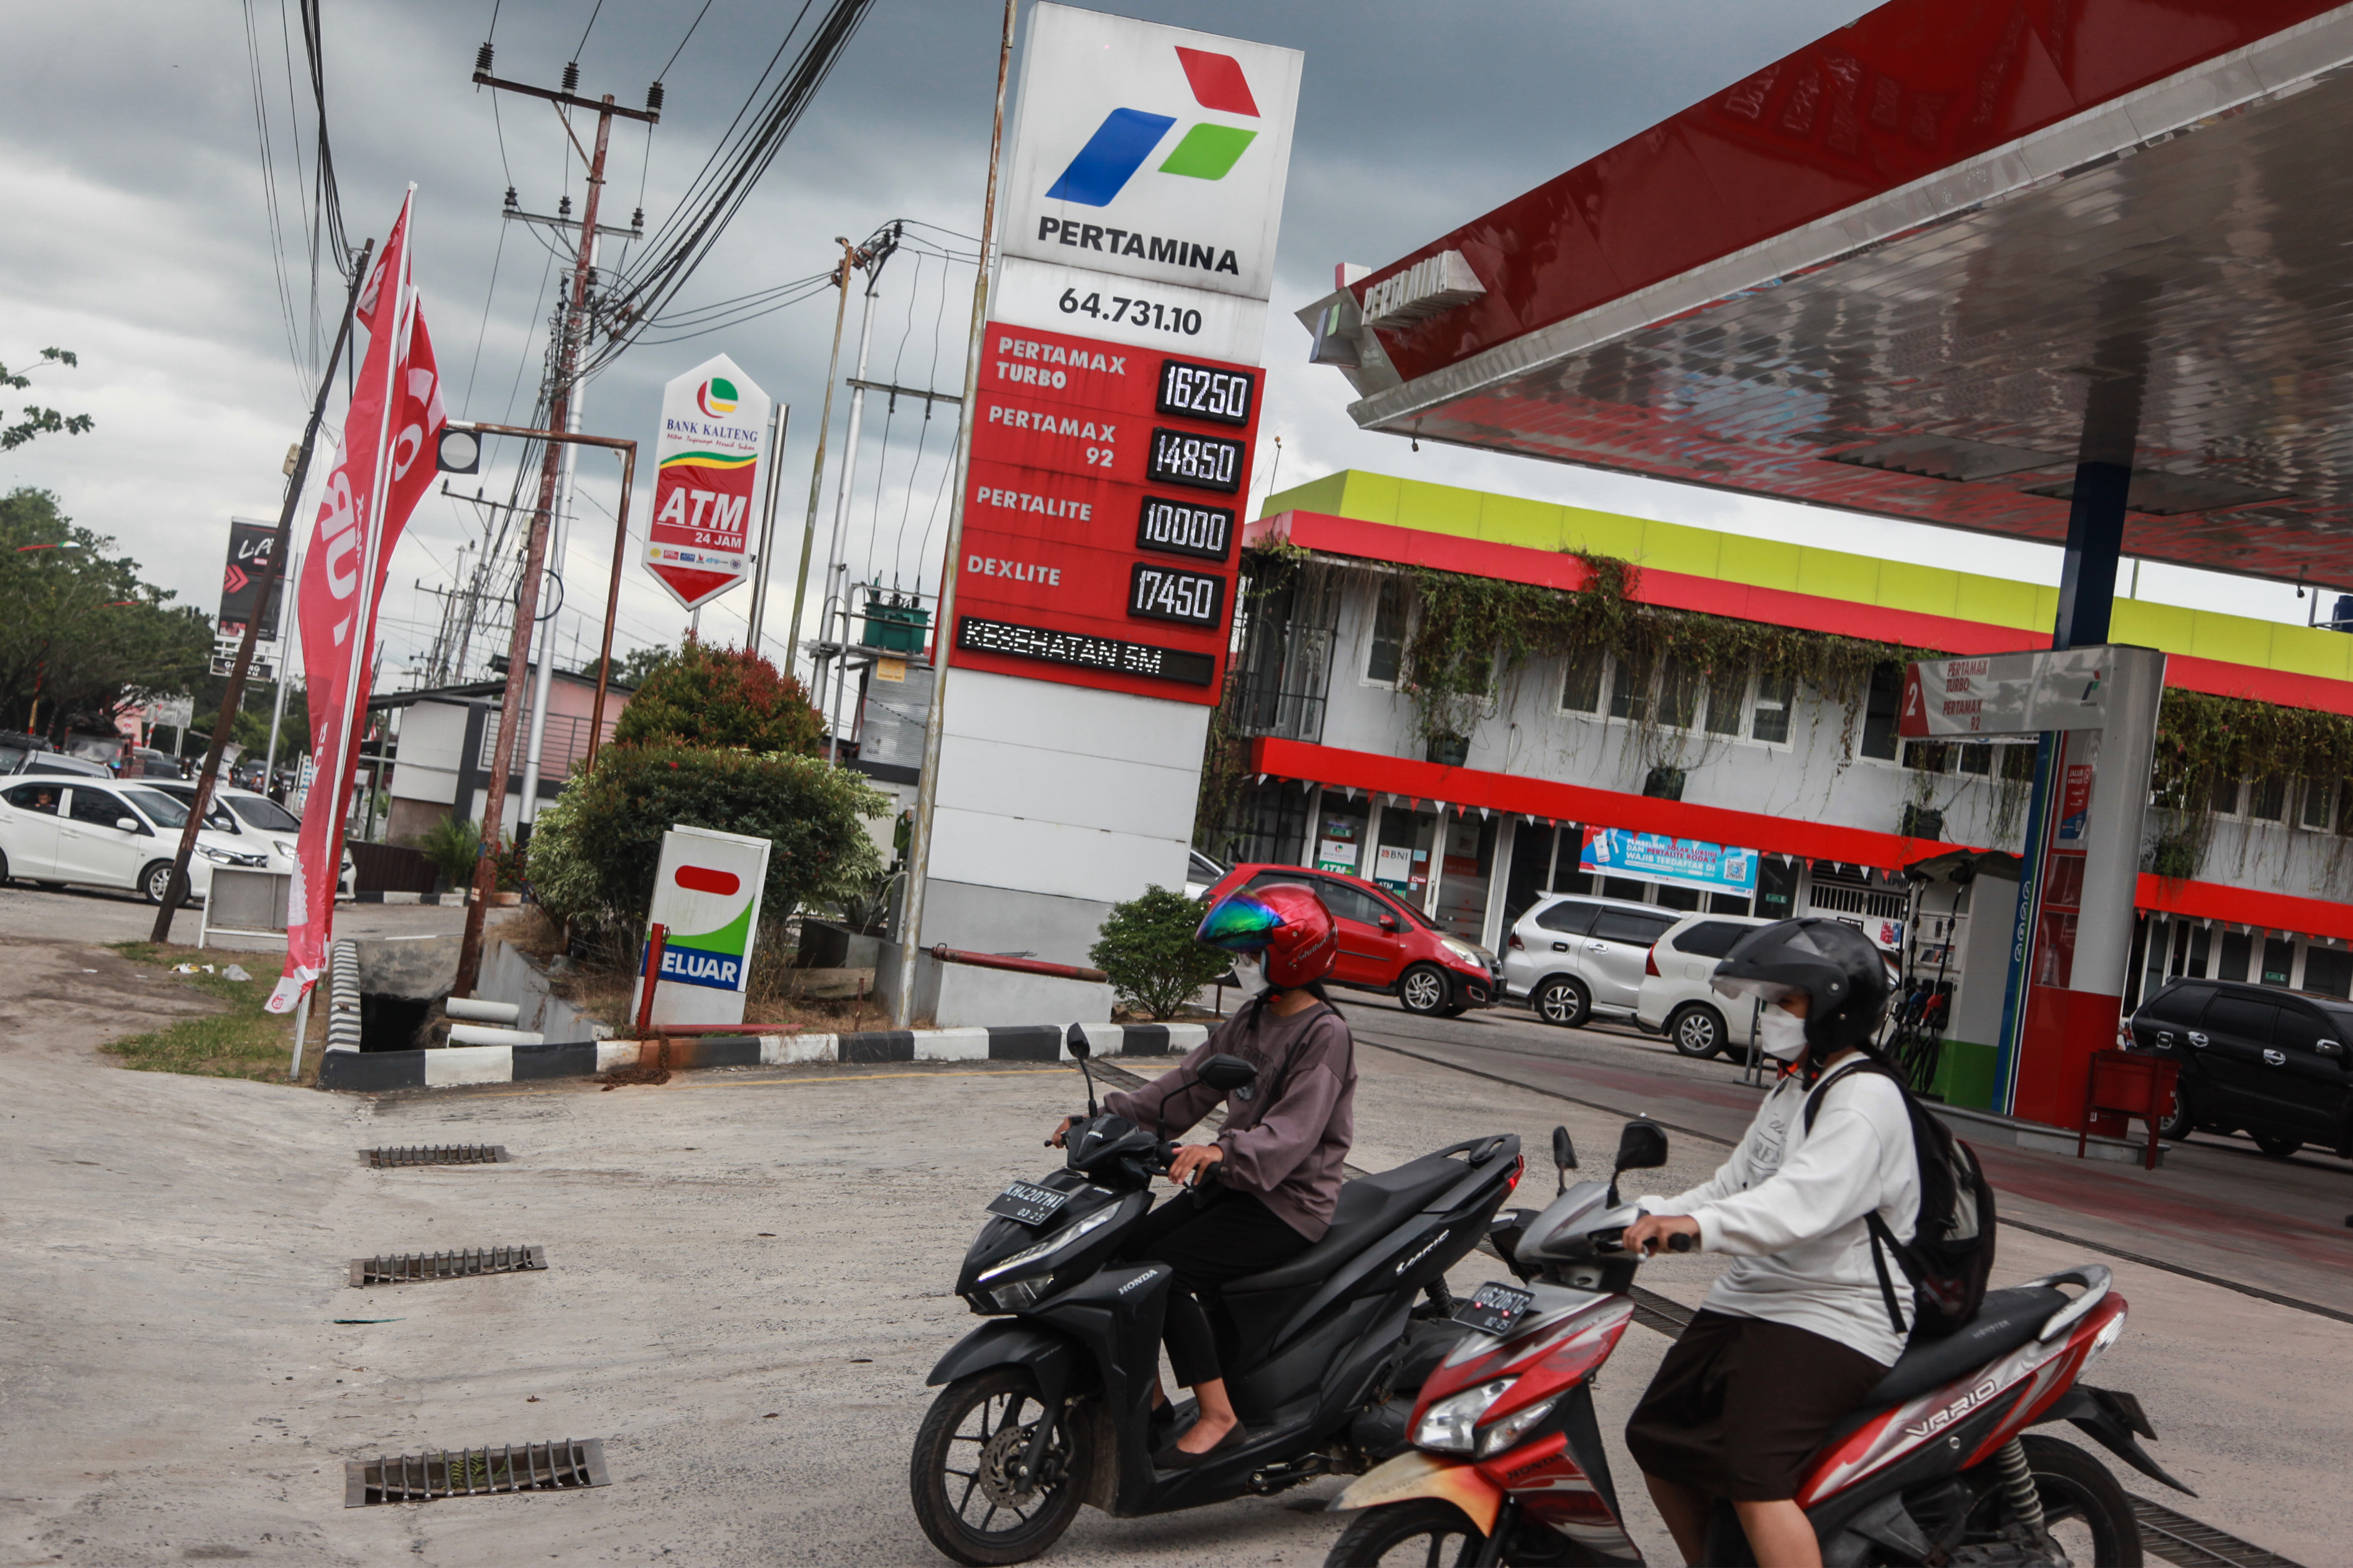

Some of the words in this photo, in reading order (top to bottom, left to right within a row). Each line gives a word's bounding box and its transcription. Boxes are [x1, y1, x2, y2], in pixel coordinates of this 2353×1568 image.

[1038, 216, 1239, 276] PERTAMINA
[1058, 288, 1202, 335] 64.731.10
[998, 336, 1127, 375] PERTAMAX
[997, 361, 1067, 389] TURBO
[1165, 365, 1247, 418] 16250
[667, 418, 698, 434] BANK
[703, 424, 757, 442] KALTENG
[988, 405, 1117, 443] PERTAMAX
[1086, 446, 1114, 468] 92
[1156, 435, 1236, 483] 14850
[658, 487, 748, 532] ATM
[977, 486, 1092, 522] PERTALITE
[695, 532, 710, 544] 24
[714, 535, 742, 549] JAM
[1145, 503, 1226, 551] 10000
[967, 555, 1061, 586] DEXLITE
[1137, 570, 1214, 619] 17450
[965, 620, 1118, 666] KESEHATAN
[1124, 645, 1162, 674] 5M
[1948, 660, 1988, 677] PERTAMAX
[1906, 682, 1918, 716] 2
[1946, 677, 1970, 693] TURBO
[1943, 699, 1983, 716] PERTAMAX
[1970, 716, 1980, 731] 92
[1321, 863, 1346, 874] ATM
[1390, 851, 1408, 861] BNI
[1626, 851, 1654, 863] WAJIB
[1657, 856, 1704, 870] TERDAFTAR
[1706, 864, 1715, 872] DI
[1627, 844, 1644, 852] DAN
[1647, 848, 1684, 859] PERTALITE
[1687, 854, 1708, 862] RODA
[1379, 881, 1393, 890] ATM
[661, 952, 737, 983] ELUAR
[1118, 1269, 1158, 1295] HONDA
[1905, 1380, 1997, 1436] VARIO
